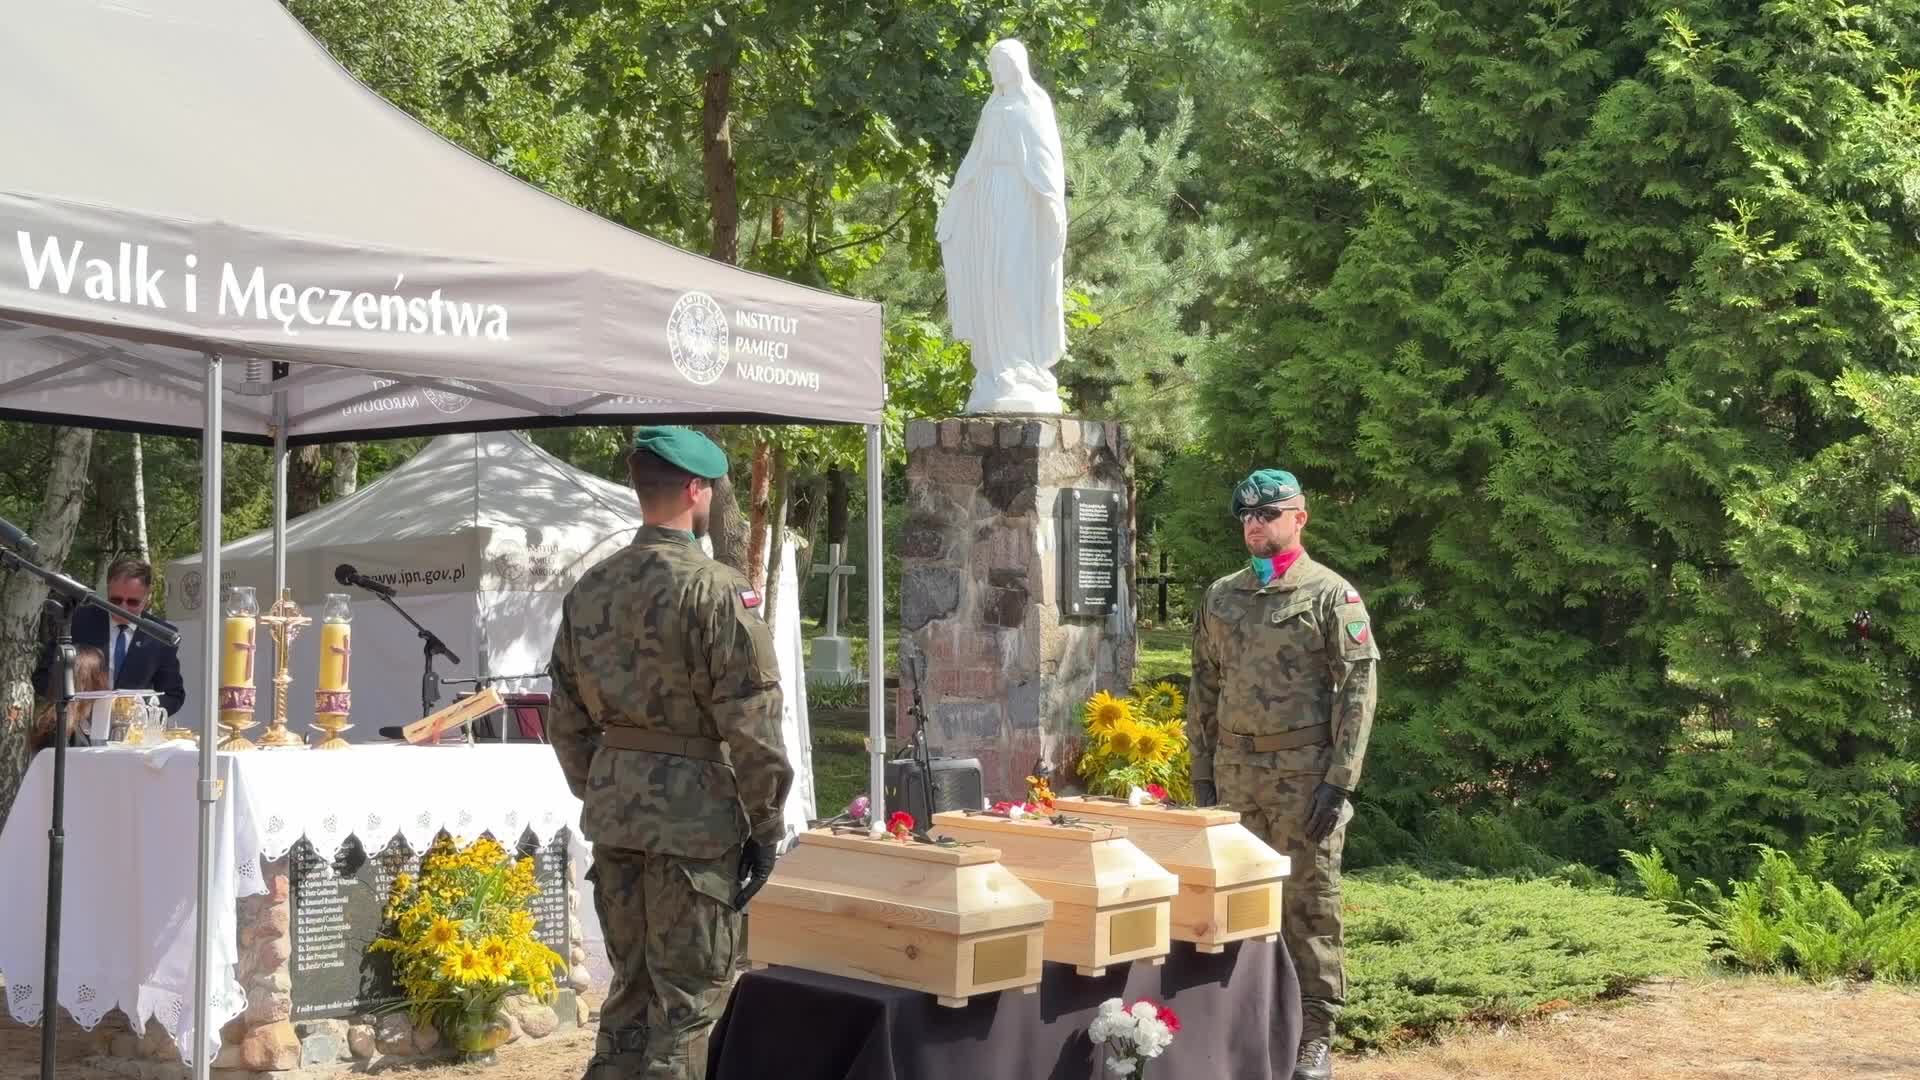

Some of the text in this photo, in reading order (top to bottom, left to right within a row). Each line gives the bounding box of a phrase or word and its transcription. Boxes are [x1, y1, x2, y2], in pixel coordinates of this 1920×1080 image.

[17, 230, 511, 342] Walk i Męczeństwa
[735, 309, 799, 336] INSTYTUT
[735, 335, 789, 362] PAMIĘCI
[736, 361, 820, 392] NARODOWEJ
[371, 563, 466, 589] ww.ipn.gov.pl
